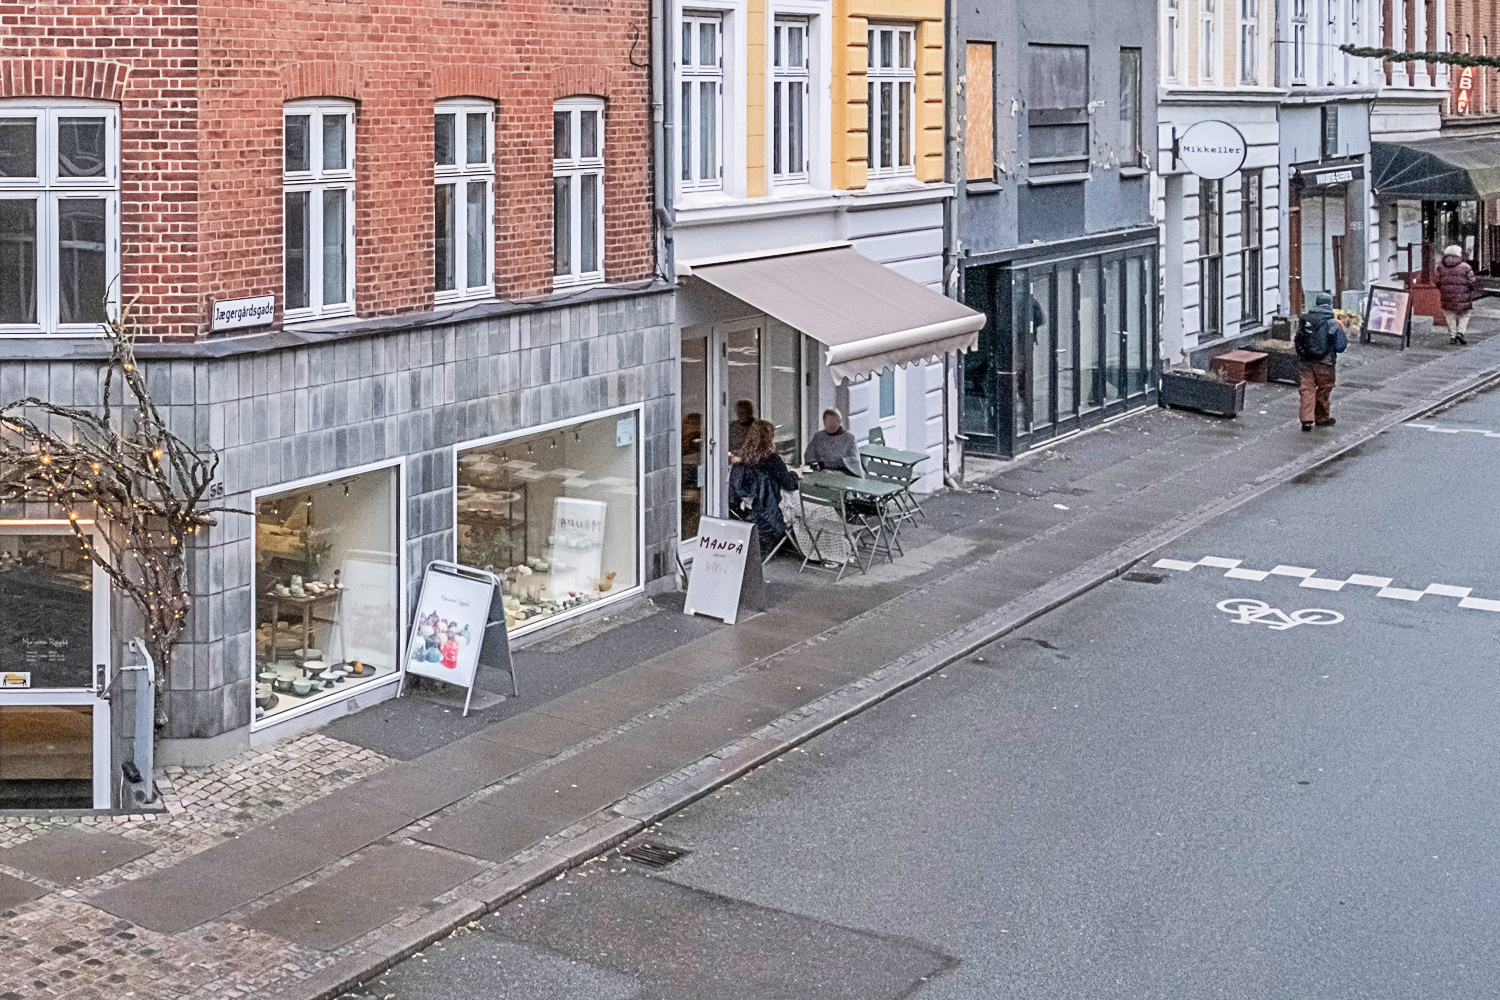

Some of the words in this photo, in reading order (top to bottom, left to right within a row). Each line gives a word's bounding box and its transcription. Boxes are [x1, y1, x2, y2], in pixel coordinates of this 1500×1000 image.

[1183, 145, 1242, 154] Mikkeller
[215, 302, 274, 323] Jægergårdsgade
[699, 536, 744, 554] MANDA
